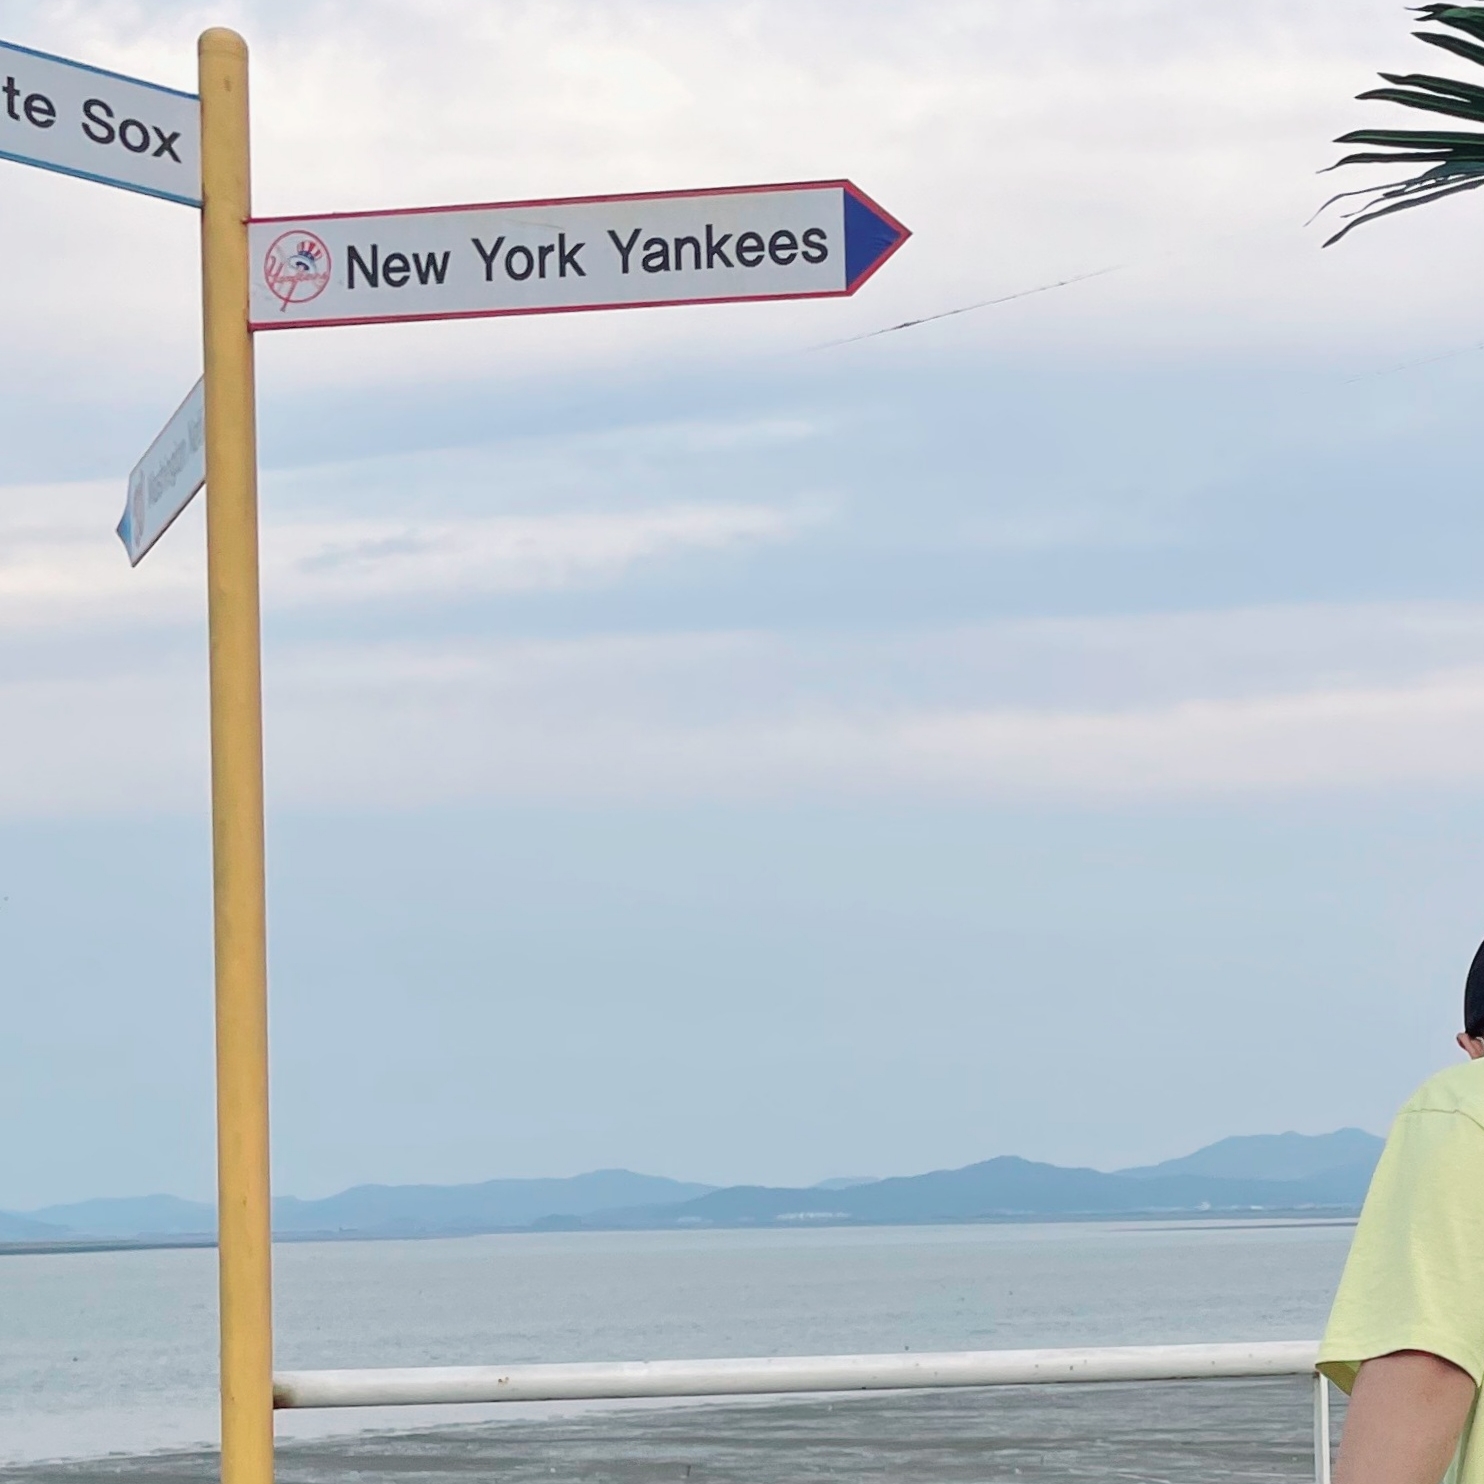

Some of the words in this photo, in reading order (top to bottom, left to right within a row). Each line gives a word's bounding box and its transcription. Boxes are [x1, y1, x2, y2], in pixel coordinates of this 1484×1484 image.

[82, 98, 182, 164] Sox
[346, 243, 451, 290] New
[471, 232, 587, 282] York
[607, 223, 829, 275] Yankees
